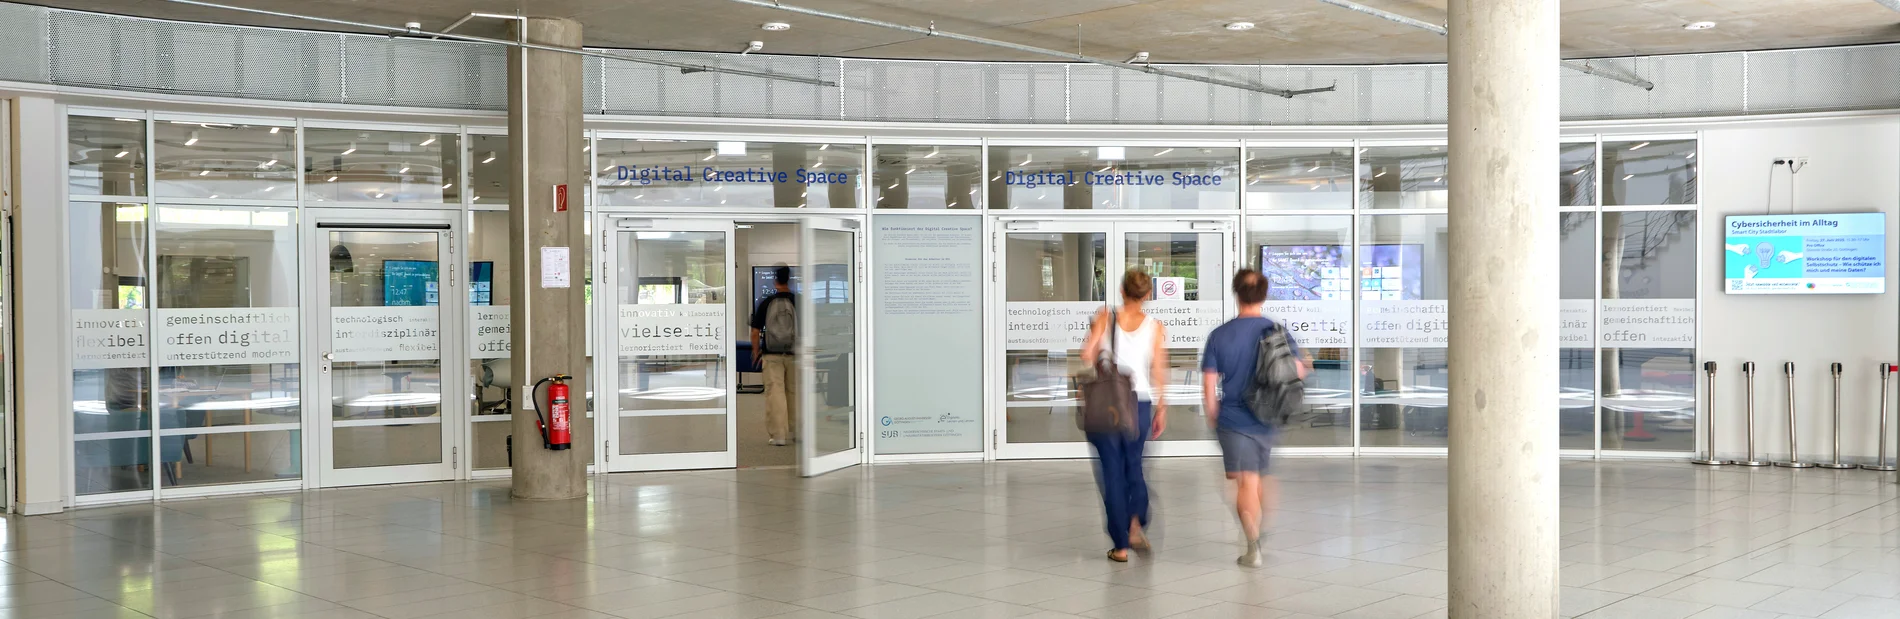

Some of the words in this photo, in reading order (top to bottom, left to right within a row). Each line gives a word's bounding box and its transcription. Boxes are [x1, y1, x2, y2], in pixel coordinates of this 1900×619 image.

[617, 165, 693, 184] Digital
[703, 166, 788, 183] Creative
[795, 168, 848, 186] Space
[1005, 170, 1074, 189] Digital
[1084, 170, 1164, 186] Creative
[1172, 171, 1222, 189] Space
[1731, 220, 1798, 229] Cybersicherheit
[1799, 219, 1811, 227] im
[1812, 219, 1838, 228] Alltag
[620, 308, 676, 318] innovativ
[1007, 308, 1071, 317] technologisch
[1603, 304, 1668, 313] lernorientiert
[76, 318, 146, 330] innovativ
[166, 312, 291, 326] gemeinschaftlich
[335, 315, 404, 325] technologisch
[1603, 315, 1694, 326] gemeinschaftlich
[1366, 320, 1402, 331] offen
[1406, 319, 1449, 333] digit
[335, 328, 438, 340] interdisziplinär
[620, 323, 724, 341] vielseitig
[1603, 329, 1647, 342] offen
[1652, 333, 1693, 342] interaktiv
[76, 334, 146, 348] flexibel
[166, 332, 212, 345] offen
[218, 329, 292, 347] digital
[1315, 336, 1347, 344] flexibel
[1366, 335, 1429, 344] unterstützend
[399, 343, 438, 352] flexibel
[620, 343, 683, 352] lernorientiert
[166, 349, 247, 361] unterstützend
[252, 348, 291, 358] modern
[881, 430, 899, 438] SUB
